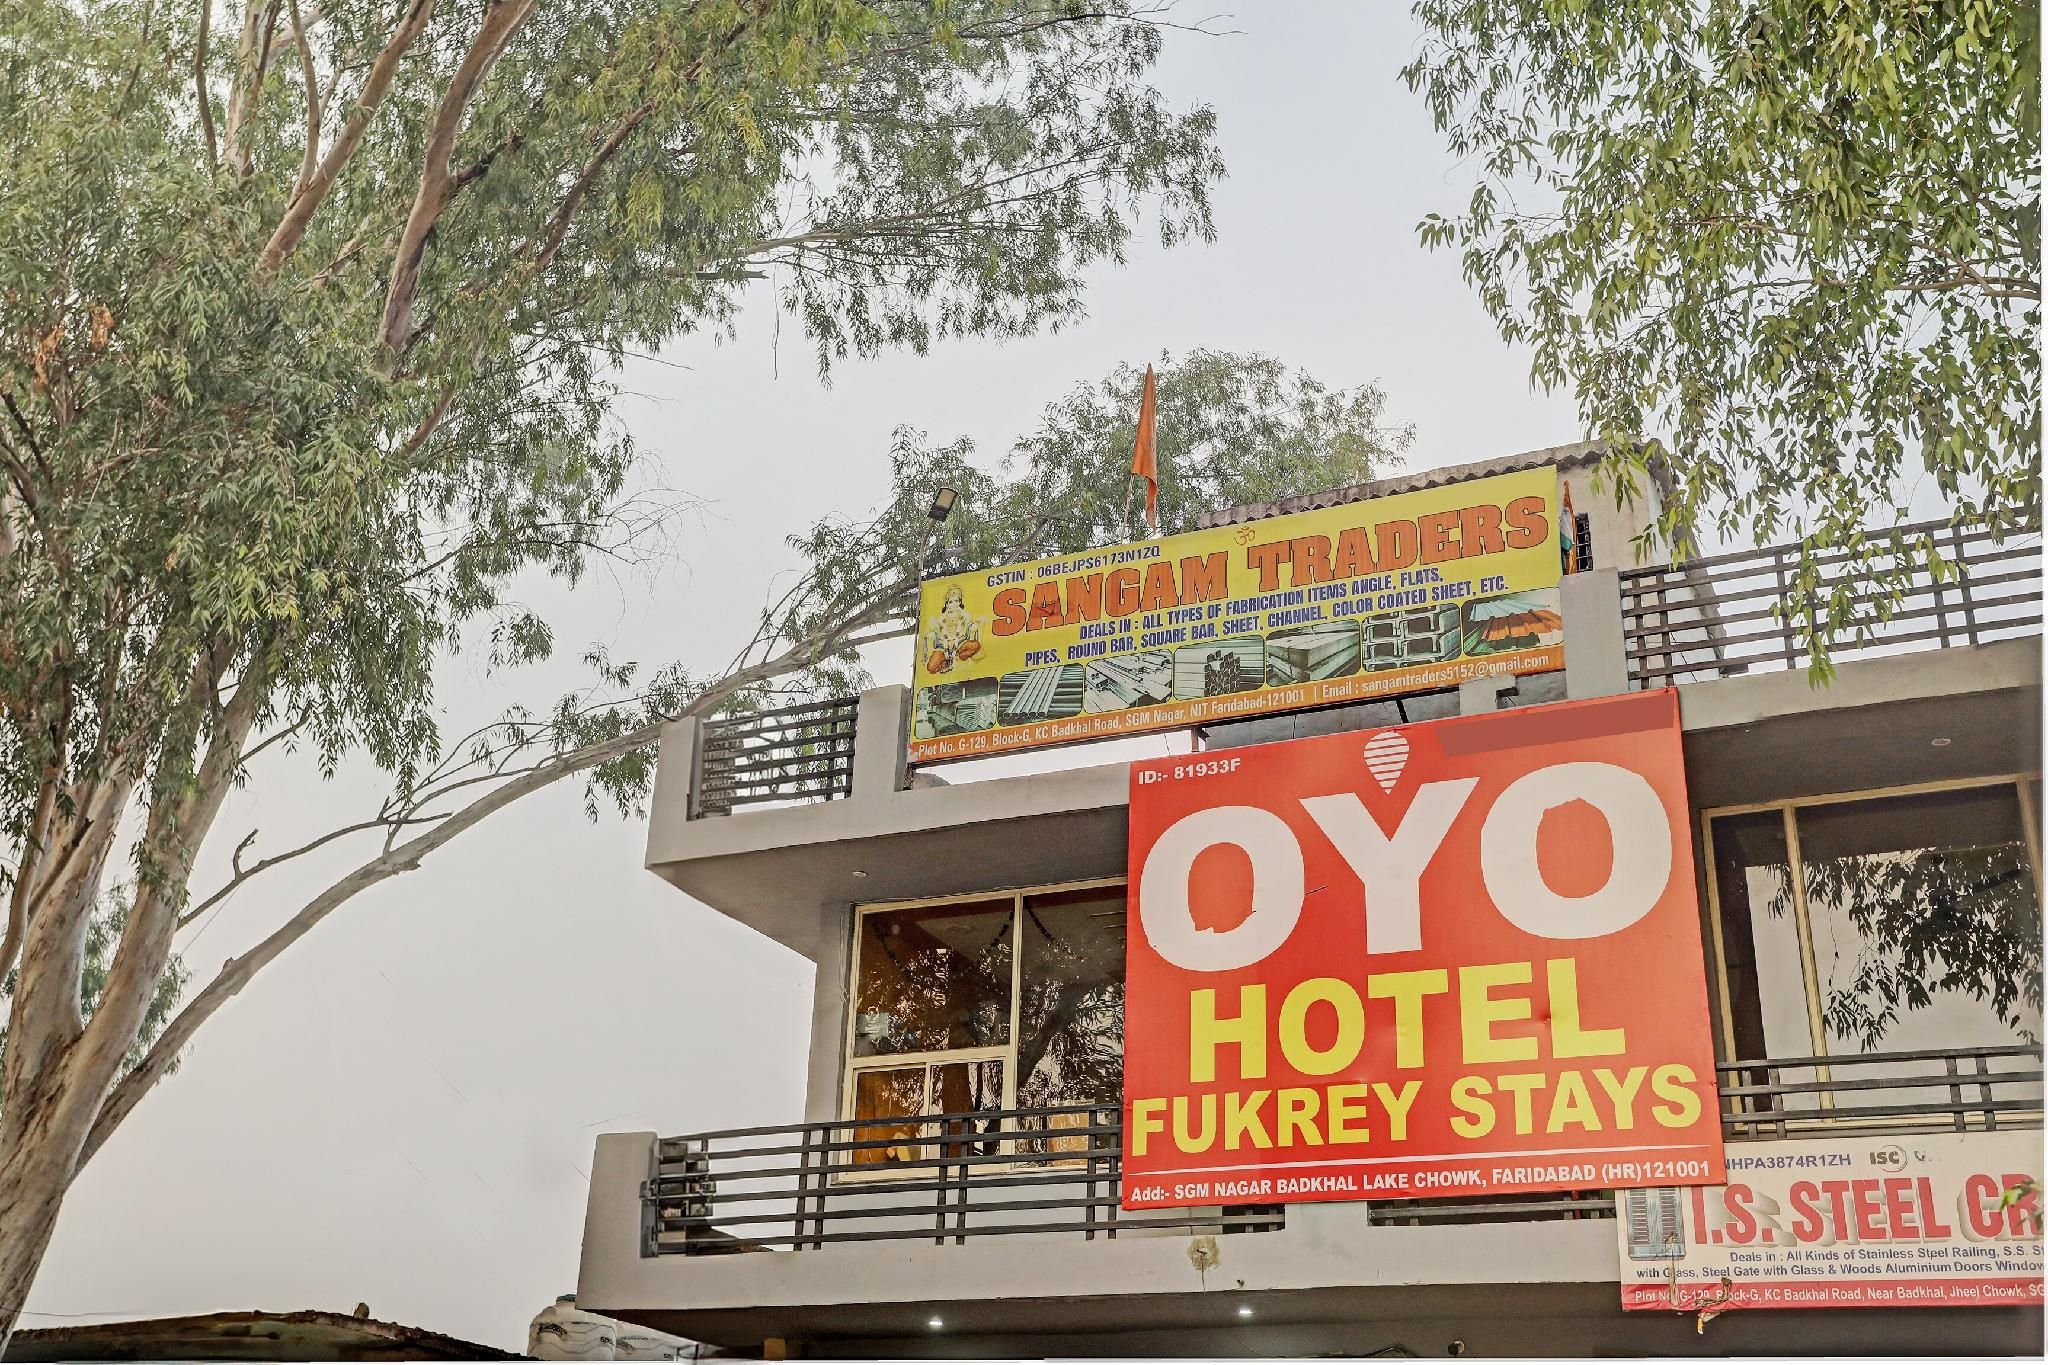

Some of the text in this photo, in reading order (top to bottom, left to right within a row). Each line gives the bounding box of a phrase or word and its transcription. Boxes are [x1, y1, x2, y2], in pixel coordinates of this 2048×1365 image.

[987, 569, 1026, 587] GSTIN
[991, 496, 1549, 637] SANGAM TRADERS
[1025, 575, 1509, 668] PIPES, ROUND BAR, SQUARE BAR, SHEET, CHANNEL, COLOR COATED SHEET, ETC.
[1079, 621, 1115, 640] DEALS
[1119, 618, 1131, 632] IN
[1142, 614, 1164, 630] ALL
[1167, 606, 1203, 626] TYPES
[1207, 603, 1222, 620] OF
[1225, 591, 1304, 617] FABRICATION
[1307, 582, 1347, 603] ITEMS
[1351, 574, 1396, 596] ANGLE,
[1400, 567, 1444, 588] FLATS,
[918, 743, 937, 758] Plot
[939, 741, 956, 754] No.
[958, 736, 990, 751] G-129,
[992, 729, 1032, 747] Block-G,
[1035, 726, 1049, 740] KC
[1051, 720, 1091, 738] Badkhal
[1094, 715, 1122, 732] Road,
[1125, 712, 1150, 727] SGM
[1153, 708, 1186, 725] Nagar,
[1190, 702, 1209, 717] NIT
[1211, 689, 1304, 715] Faridabad-121001
[1322, 678, 1352, 697] Email
[1362, 655, 1550, 692] sangamtraders5152@gmail.com
[1138, 757, 1241, 785] ID:- 81933F
[1139, 761, 1673, 972] OYO
[1189, 957, 1627, 1083] HOTEL
[1131, 1063, 1702, 1157] FUKREY STAYS
[1130, 1160, 1710, 1202] Add:- SGM NAGAR BADKHAL LAKE CHOWK, FARIDABAD (HR)121001
[1869, 1150, 1900, 1165] ISC
[1690, 1183, 1774, 1245] I.S.
[1789, 1176, 1952, 1244] STEEL
[1636, 1267, 1660, 1278] with
[1663, 1267, 1699, 1279] Gass,
[1702, 1266, 1730, 1277] Steel
[1733, 1266, 1760, 1277] Gate
[1763, 1264, 1788, 1276] with
[1791, 1263, 1824, 1275] Glass
[1828, 1264, 1837, 1274] &
[1840, 1263, 1882, 1274] Woods
[1885, 1262, 1952, 1273] Aluminium
[1954, 1261, 1993, 1272] Doors
[1730, 1251, 1762, 1263] Deals
[1765, 1252, 1776, 1262] in
[1786, 1250, 1801, 1262] All
[1805, 1248, 1839, 1262] Kinds
[1843, 1248, 1856, 1260] of
[1858, 1247, 1914, 1260] Stainless
[1952, 1246, 2000, 1259] Railing,
[2003, 1245, 2029, 1256] S.S.
[1635, 1290, 1656, 1302] Plot
[1764, 1288, 1780, 1301] KC
[1784, 1287, 1828, 1301] Badkhal
[1831, 1287, 1865, 1301] Road,
[1867, 1287, 1893, 1300] Near
[1897, 1286, 1947, 1301] Badkhal,
[1982, 1283, 2026, 1299] Chowk,
